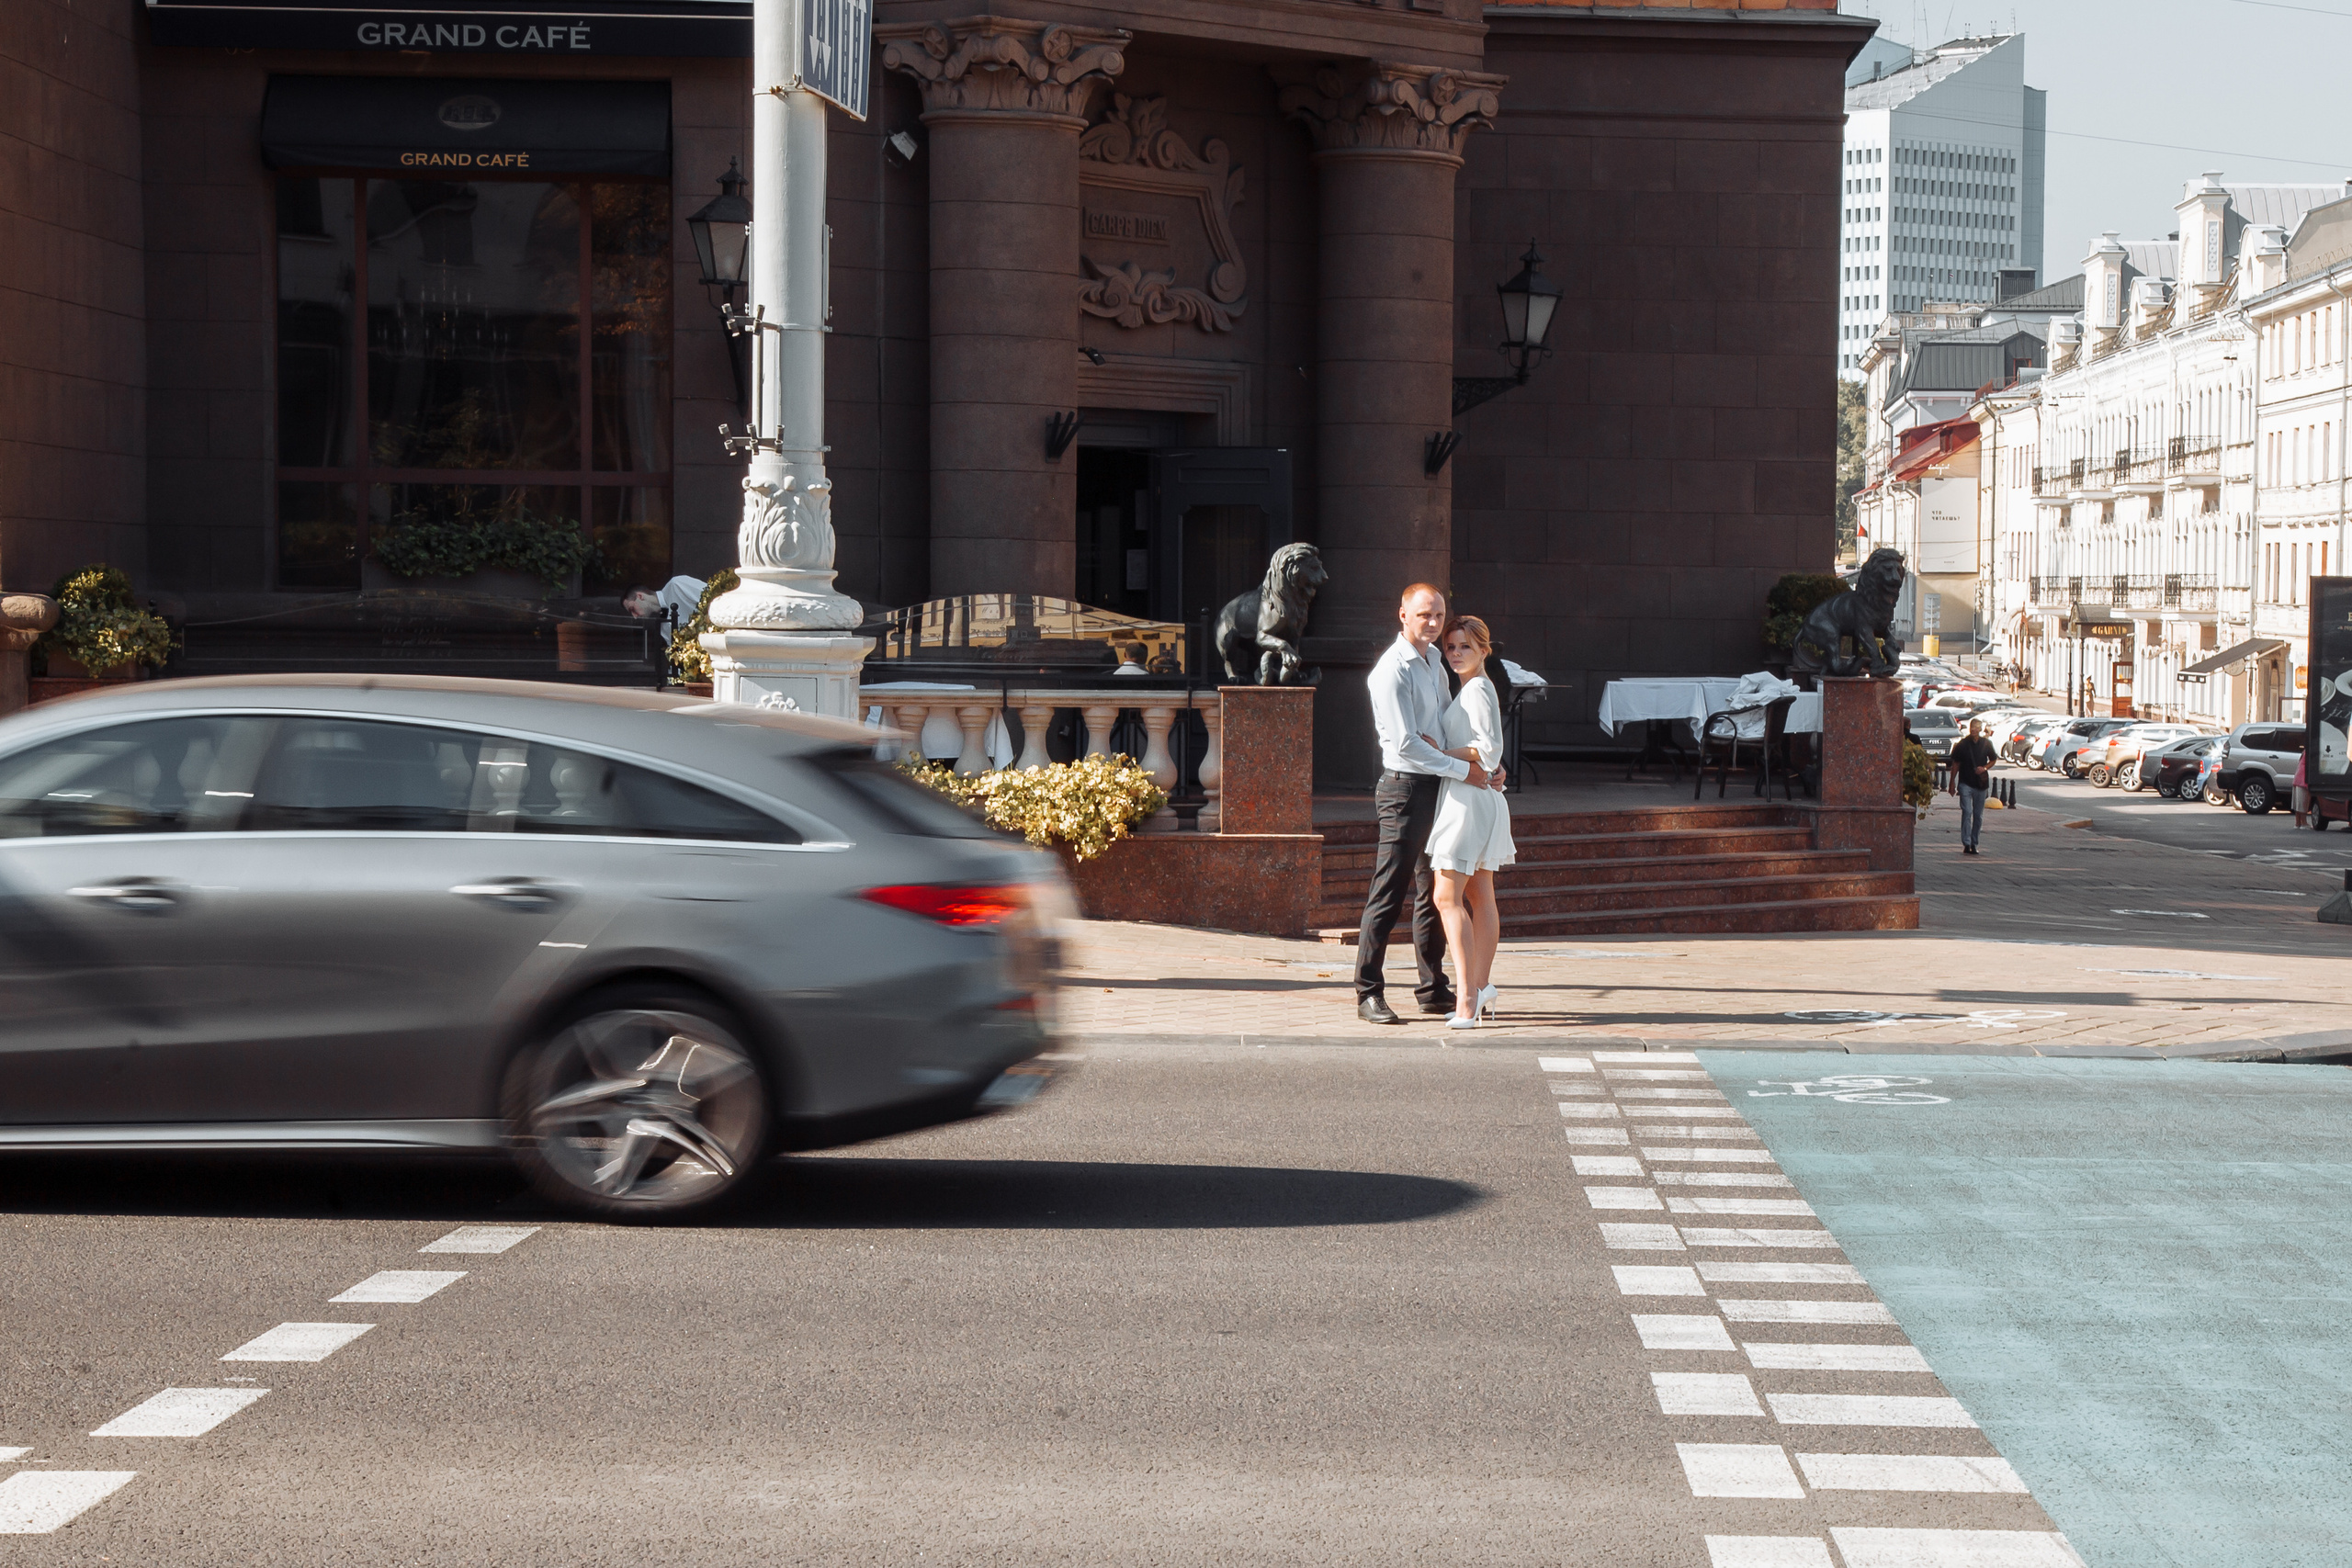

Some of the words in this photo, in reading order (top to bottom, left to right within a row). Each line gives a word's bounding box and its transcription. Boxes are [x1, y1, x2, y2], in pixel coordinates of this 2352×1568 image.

[356, 22, 486, 47] GRAND
[495, 21, 591, 49] CAFÉ
[401, 152, 472, 166] GRAND
[476, 152, 530, 167] CAFÉ
[1089, 213, 1131, 237] CARPE
[1135, 217, 1167, 241] DIEM
[2098, 626, 2121, 635] GARNI
